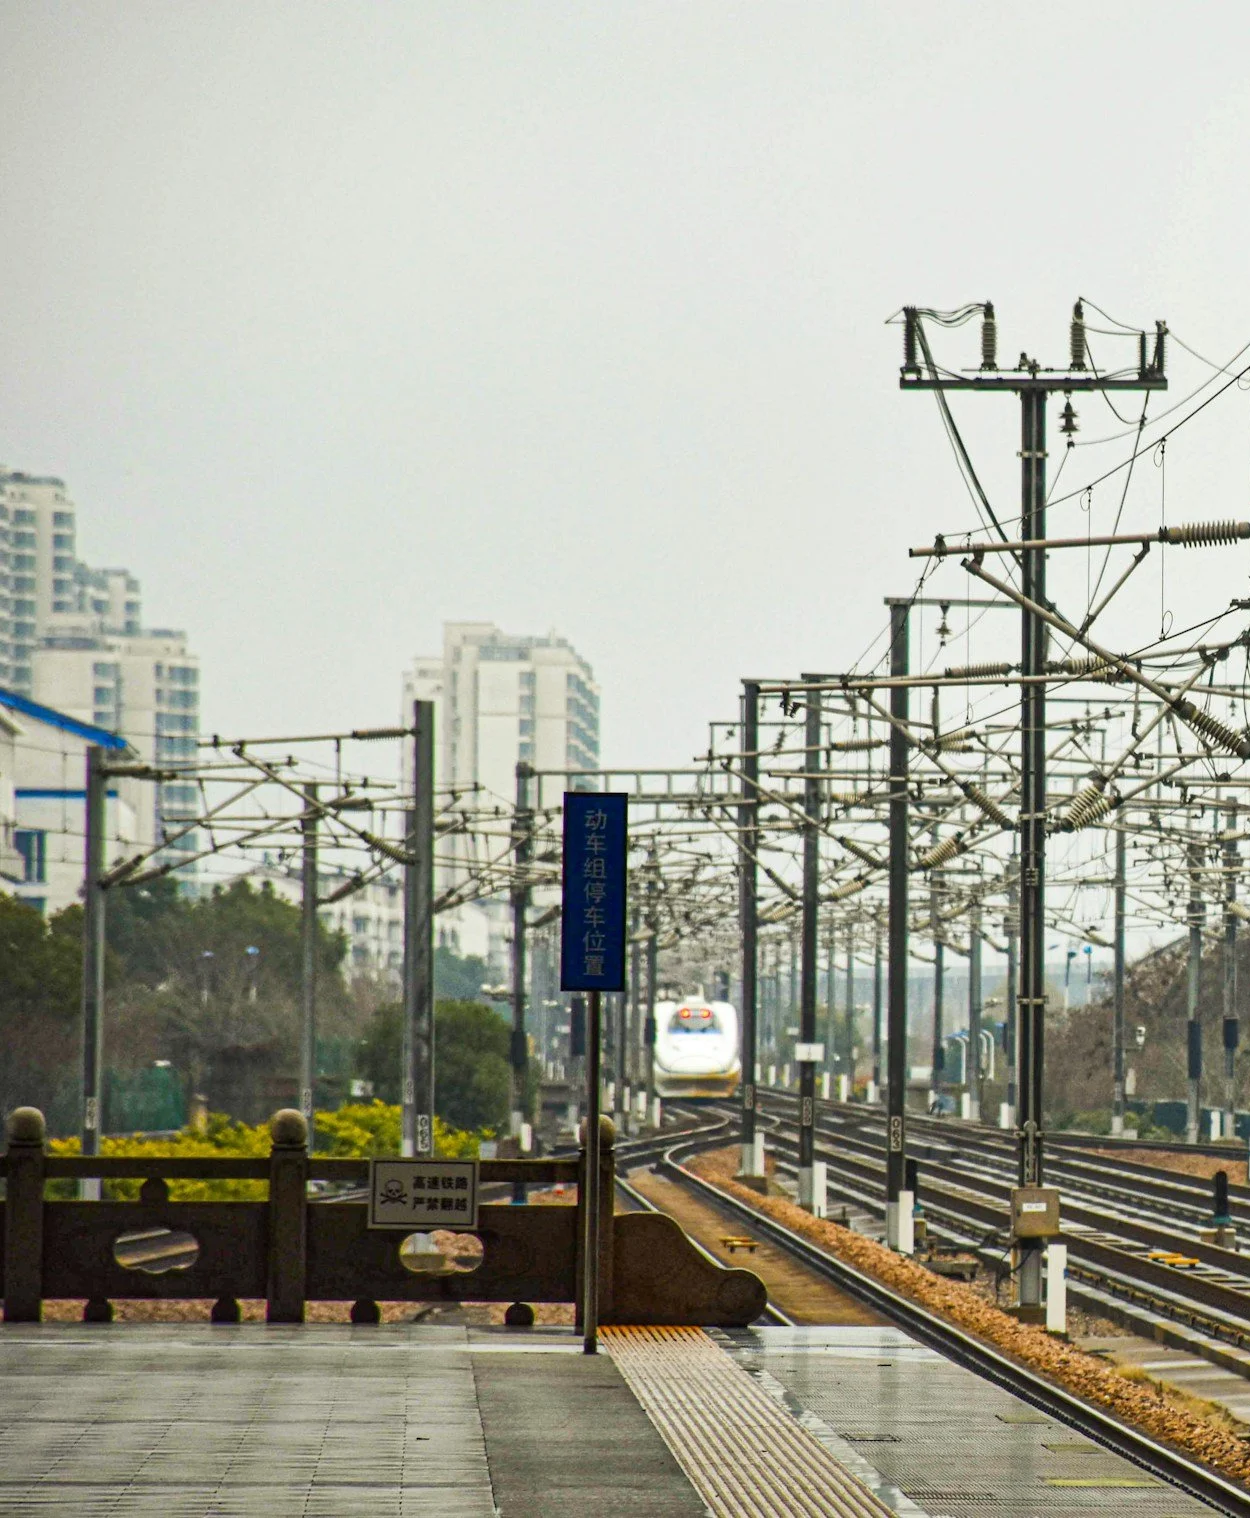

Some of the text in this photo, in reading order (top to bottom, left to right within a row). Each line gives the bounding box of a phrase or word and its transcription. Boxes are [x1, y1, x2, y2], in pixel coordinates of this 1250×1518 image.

[583, 809, 608, 976] 动车组停车位置
[412, 1176, 468, 1190] 高速铁路
